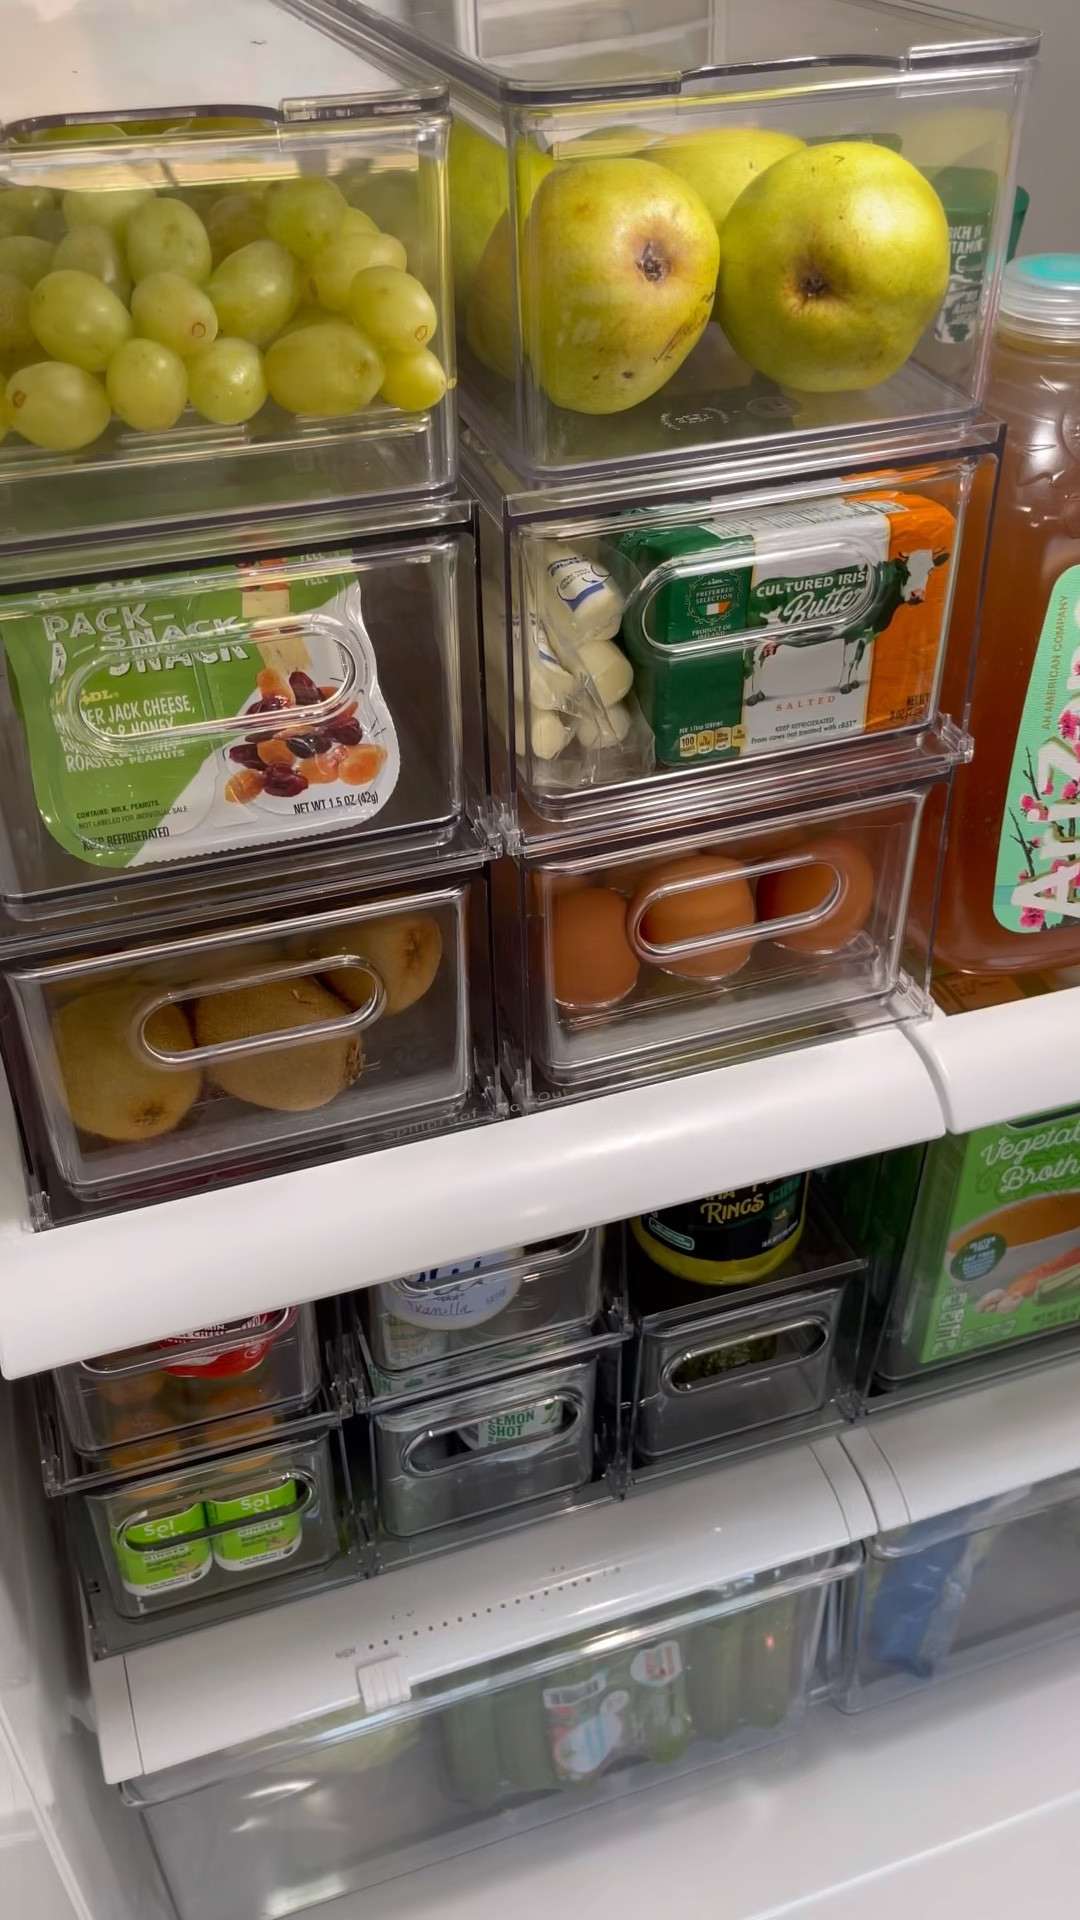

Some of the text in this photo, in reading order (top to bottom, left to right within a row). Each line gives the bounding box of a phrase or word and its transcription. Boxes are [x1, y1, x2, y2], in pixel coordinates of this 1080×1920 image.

[695, 586, 735, 599] PREFERRED
[695, 593, 733, 605] SELECTION
[756, 576, 835, 599] CULTURED
[691, 623, 732, 637] PRODUCT OF
[1041, 594, 1069, 731] AN AMERICAN COMPANY
[108, 702, 141, 723] JACK
[143, 694, 196, 717] CHEESE,
[775, 695, 837, 713] SALTED
[751, 736, 768, 745] From
[768, 732, 786, 742] cows
[786, 729, 798, 740] not
[798, 726, 822, 738] treated
[822, 722, 838, 734] with
[774, 716, 835, 733] KEEP REFRIGERATED
[681, 736, 695, 747] 100
[65, 749, 186, 773] ROASTED PEANUTS
[293, 789, 379, 815] NET WT 1.5 OZ (42g)
[78, 805, 188, 830] NOT LABELED FOR INDIVIDUAL SALE
[106, 826, 170, 847] REFRIGERATED
[999, 1154, 1080, 1193] Broth
[699, 1193, 766, 1225] RINGS
[488, 1424, 524, 1438] SHOT
